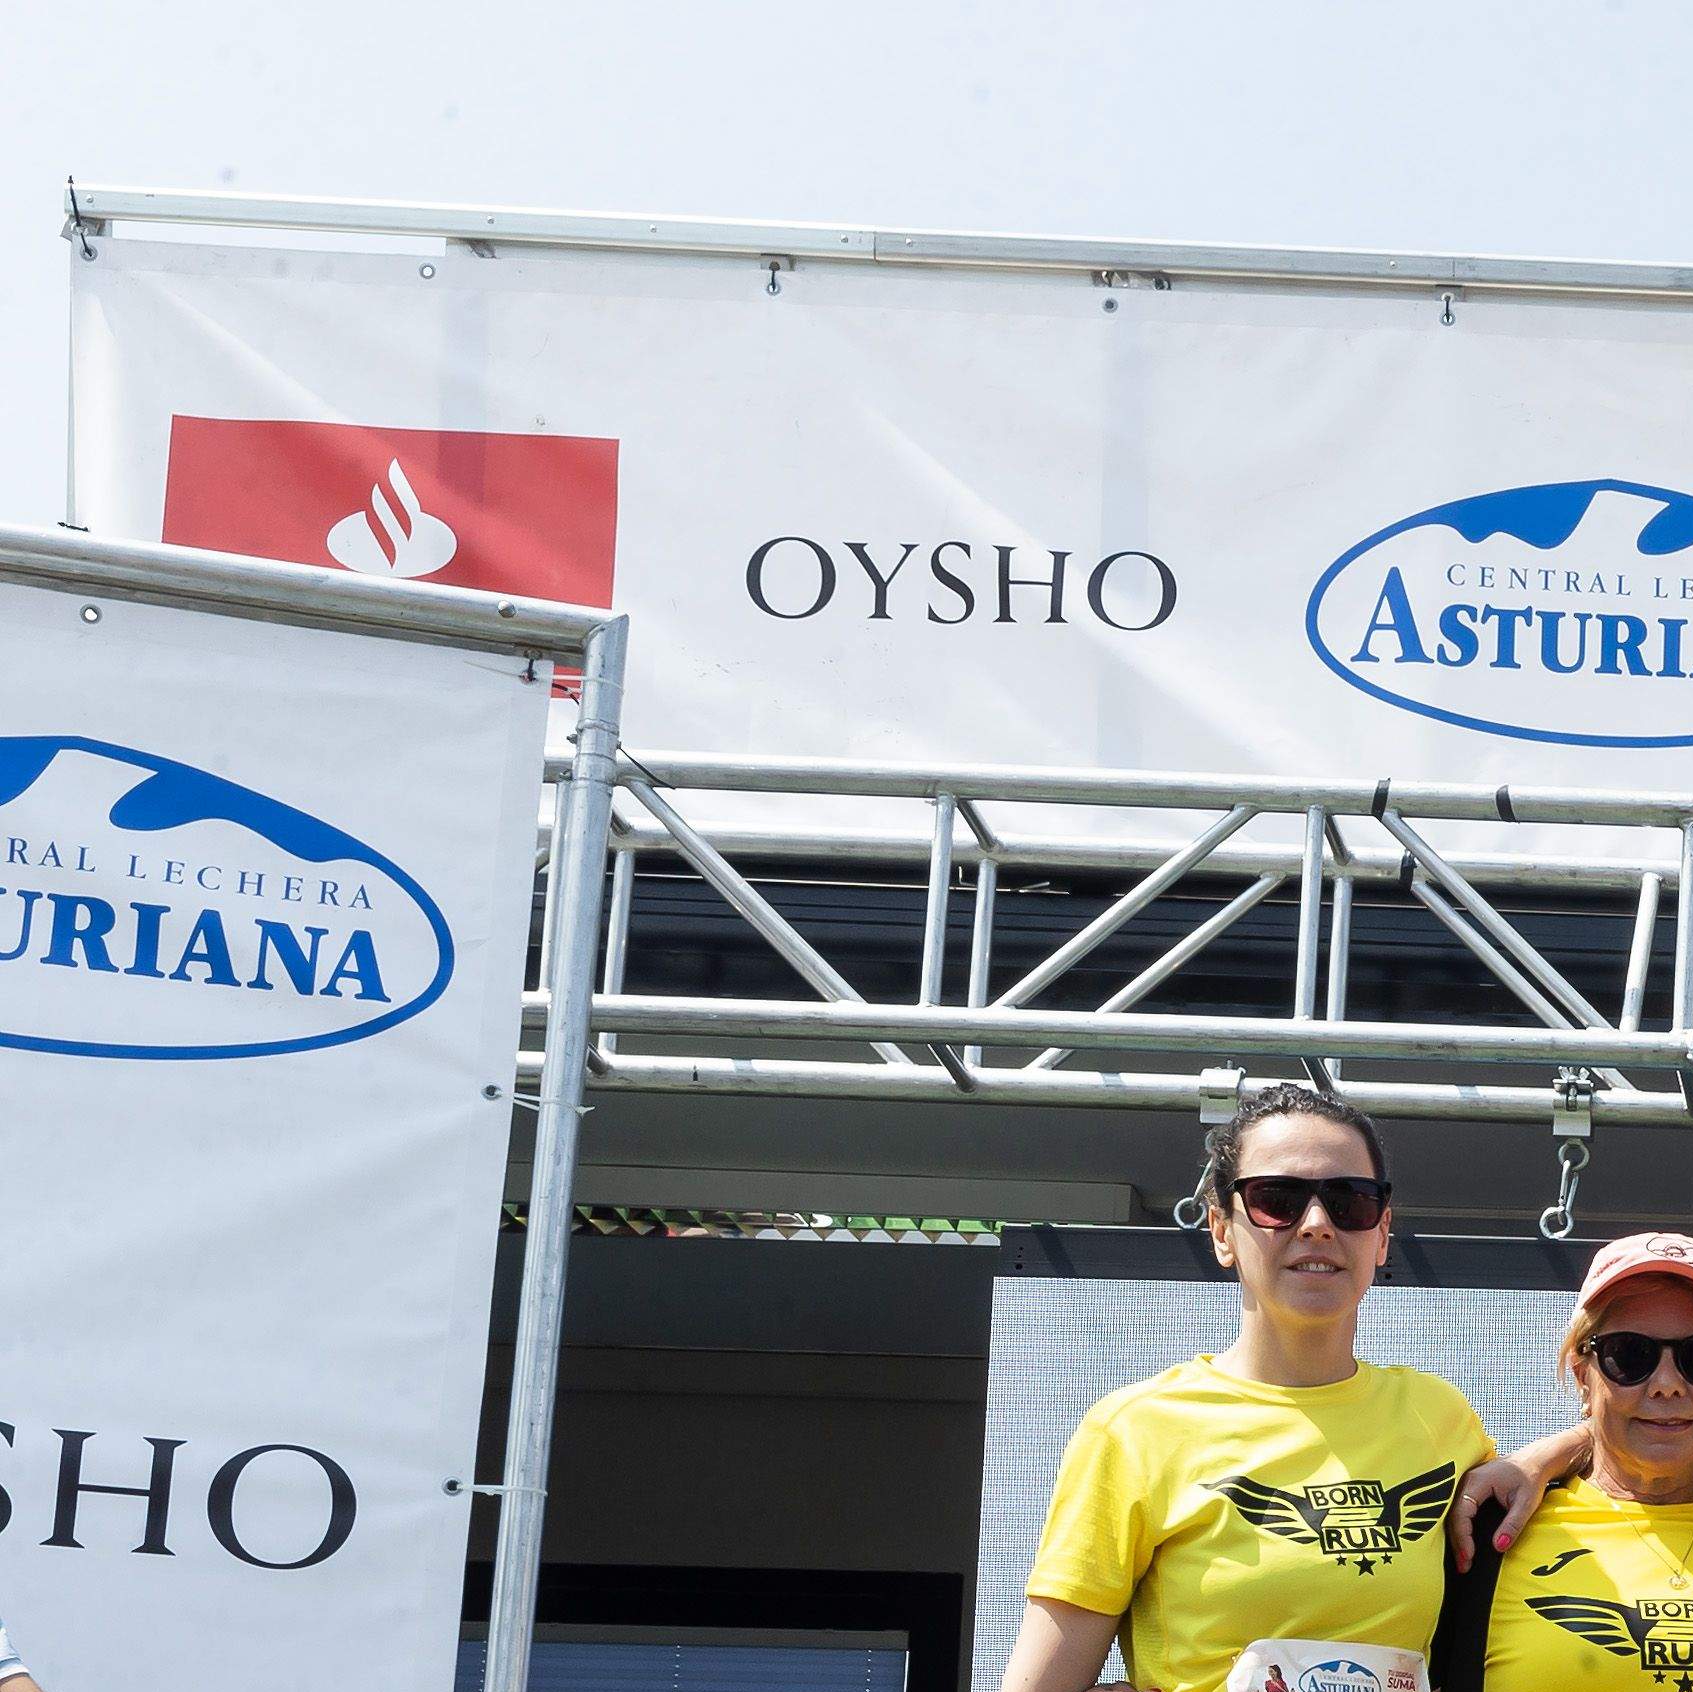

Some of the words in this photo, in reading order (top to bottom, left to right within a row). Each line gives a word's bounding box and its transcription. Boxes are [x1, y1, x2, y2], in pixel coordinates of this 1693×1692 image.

[744, 535, 1179, 631] OYSHO
[1447, 563, 1633, 597] CENTRAL
[5, 836, 96, 873] RAL
[128, 854, 374, 910] LECHERA
[0, 887, 391, 1003] URIANA
[1312, 1485, 1381, 1506] BORN
[1325, 1526, 1396, 1549] RUN
[1387, 1677, 1416, 1692] SUMA
